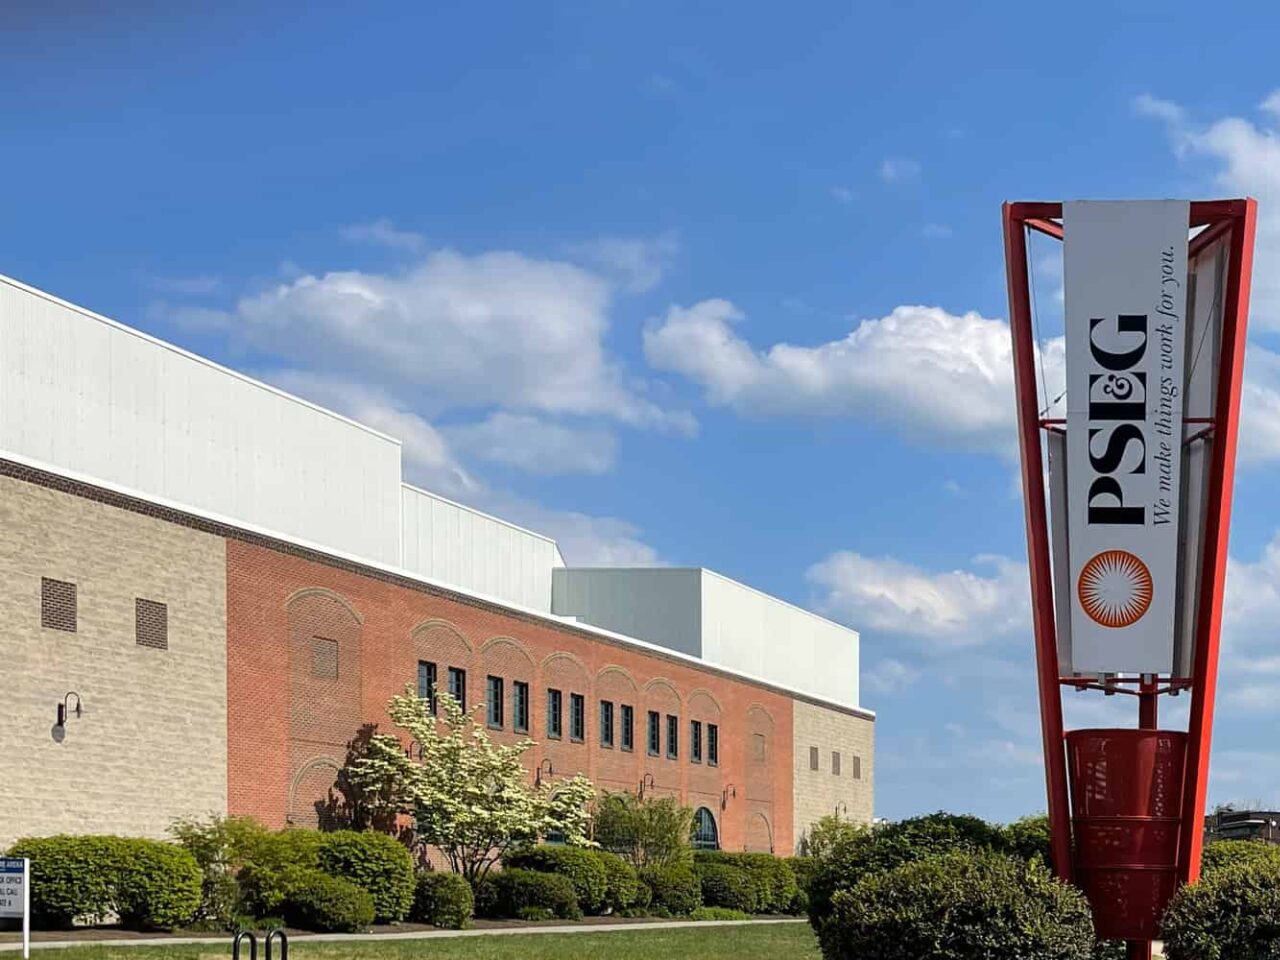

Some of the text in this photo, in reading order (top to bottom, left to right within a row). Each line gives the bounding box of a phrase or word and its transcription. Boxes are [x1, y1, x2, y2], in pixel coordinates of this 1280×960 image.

[1087, 313, 1148, 525] PSE&G
[1153, 245, 1181, 526] We make things work for you.
